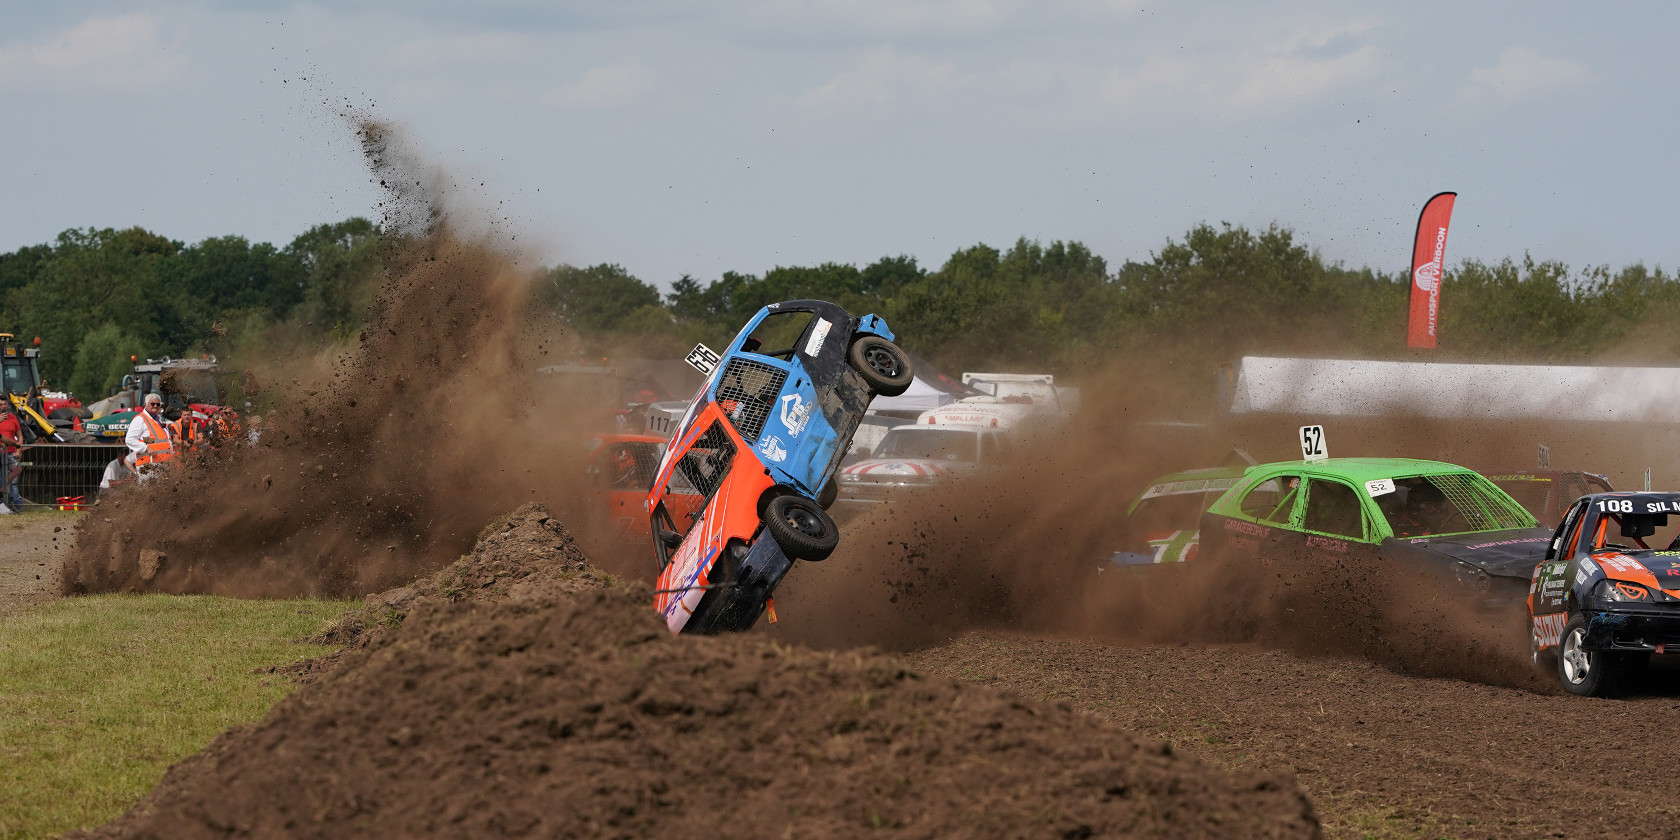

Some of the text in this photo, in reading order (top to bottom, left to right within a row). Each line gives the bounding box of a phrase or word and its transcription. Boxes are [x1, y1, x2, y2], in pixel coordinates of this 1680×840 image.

[1428, 227, 1446, 336] AUTOSPORT VERBOON
[650, 415, 669, 433] 117
[1303, 426, 1322, 456] 52
[1370, 483, 1388, 492] 52
[1595, 499, 1634, 513] 108
[1646, 501, 1671, 513] SIL
